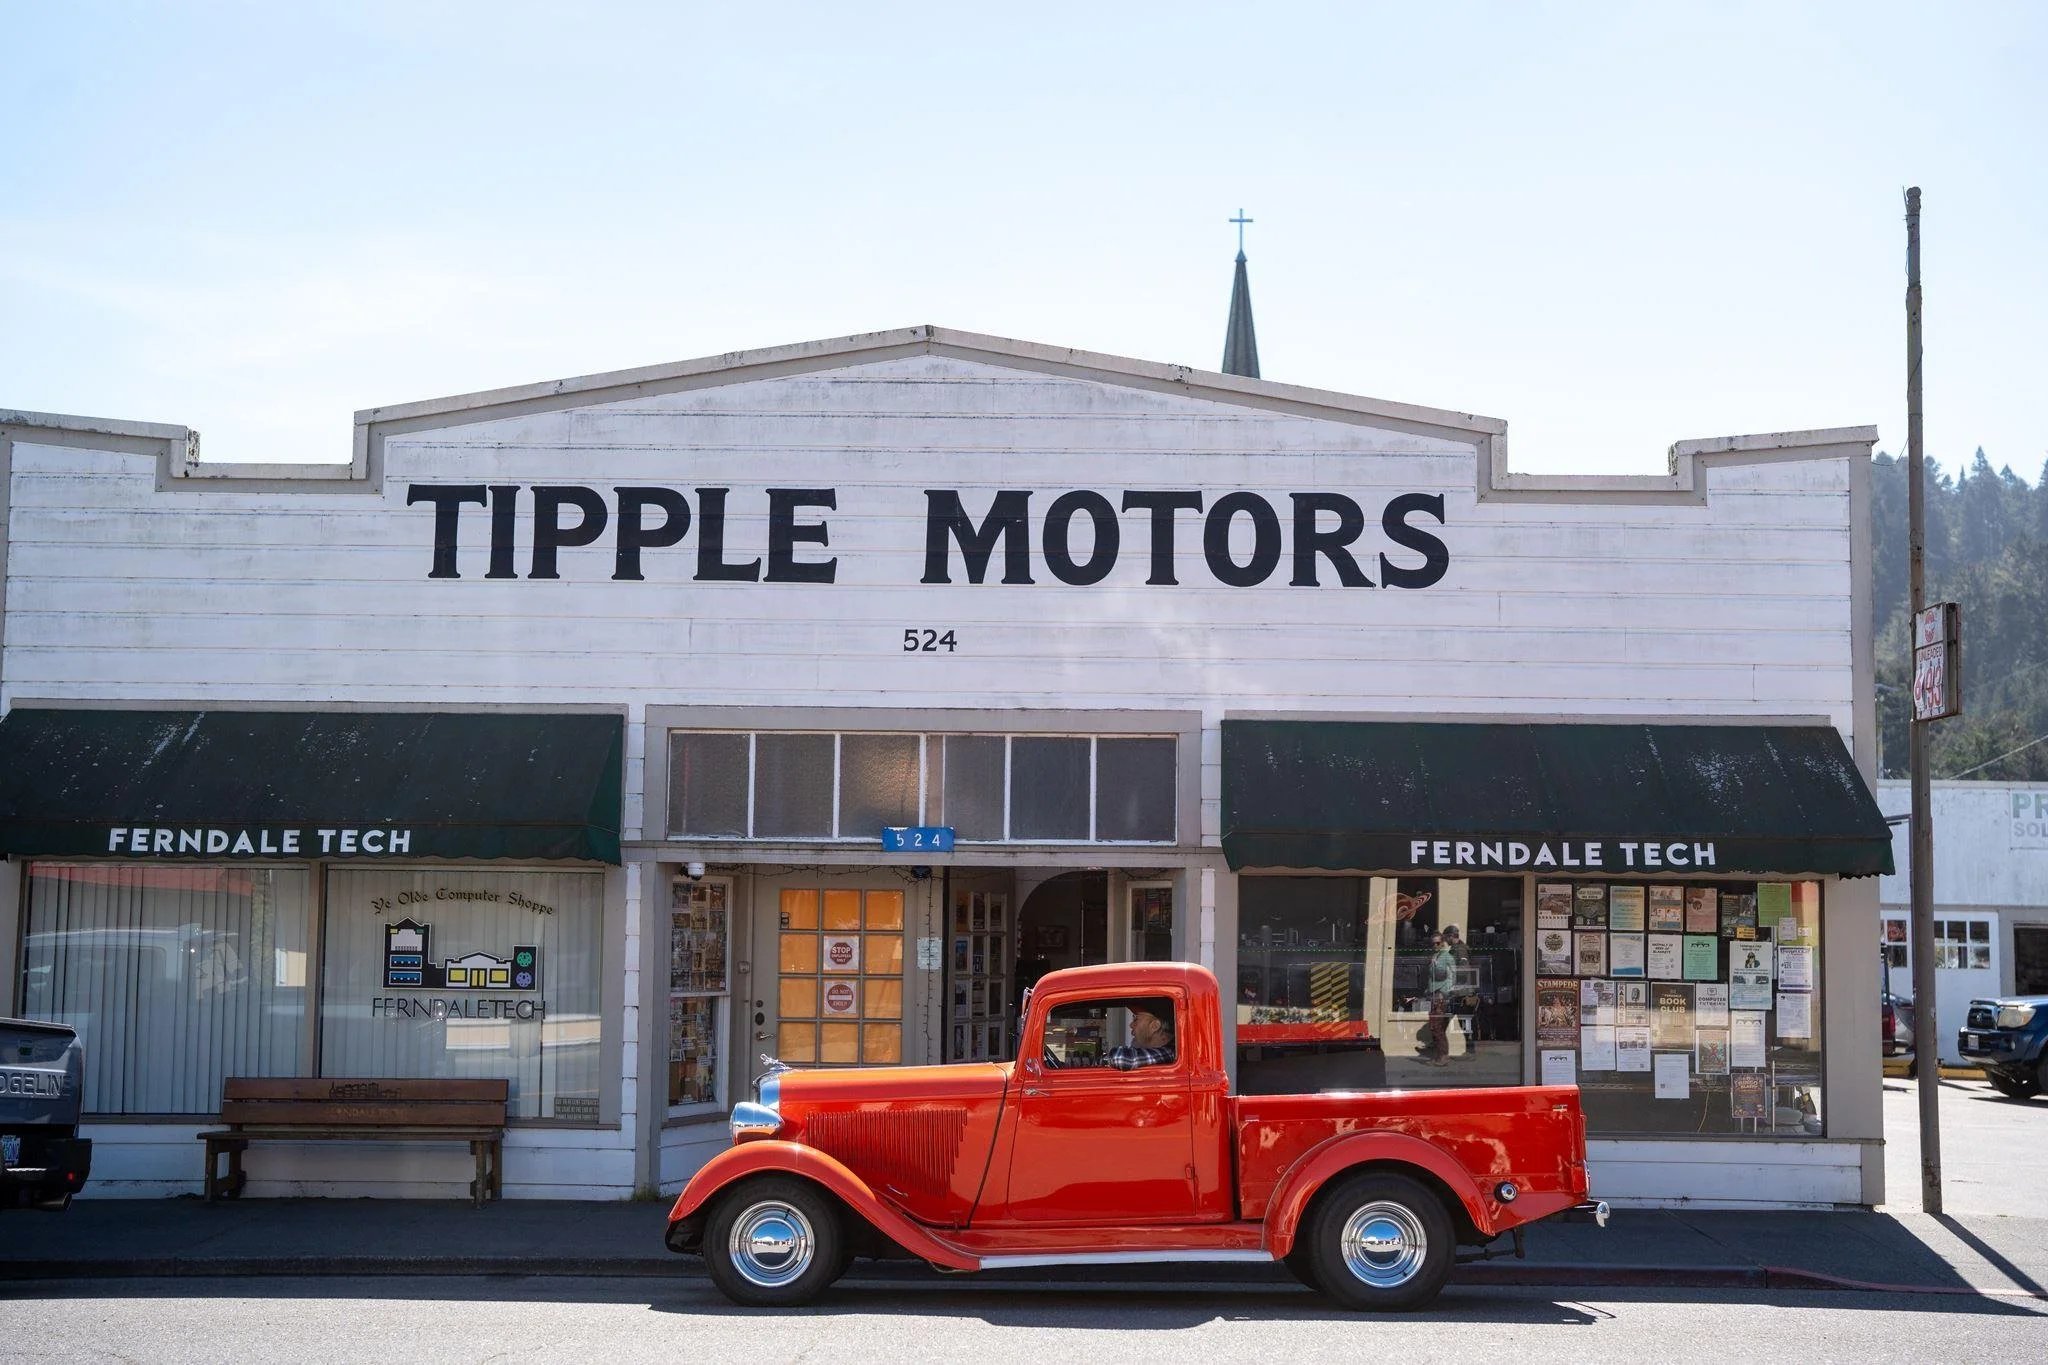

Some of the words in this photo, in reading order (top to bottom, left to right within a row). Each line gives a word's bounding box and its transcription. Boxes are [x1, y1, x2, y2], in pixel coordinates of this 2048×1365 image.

[406, 483, 838, 583] TIPPLE
[920, 489, 1450, 589] MOTORS
[903, 629, 958, 652] 524
[109, 828, 301, 854] FERNDALE
[318, 829, 411, 853] TECH
[896, 833, 941, 847] 524
[1410, 840, 1603, 866] FERNDALE
[1620, 842, 1716, 866] TECH
[371, 897, 392, 915] Ye
[398, 891, 428, 905] Olde
[436, 888, 501, 903] Computer
[507, 891, 553, 915] Shoppe
[1537, 980, 1579, 990] STAMPEDE
[372, 997, 546, 1020] FERNDALETECH
[1660, 997, 1687, 1005] BOOK
